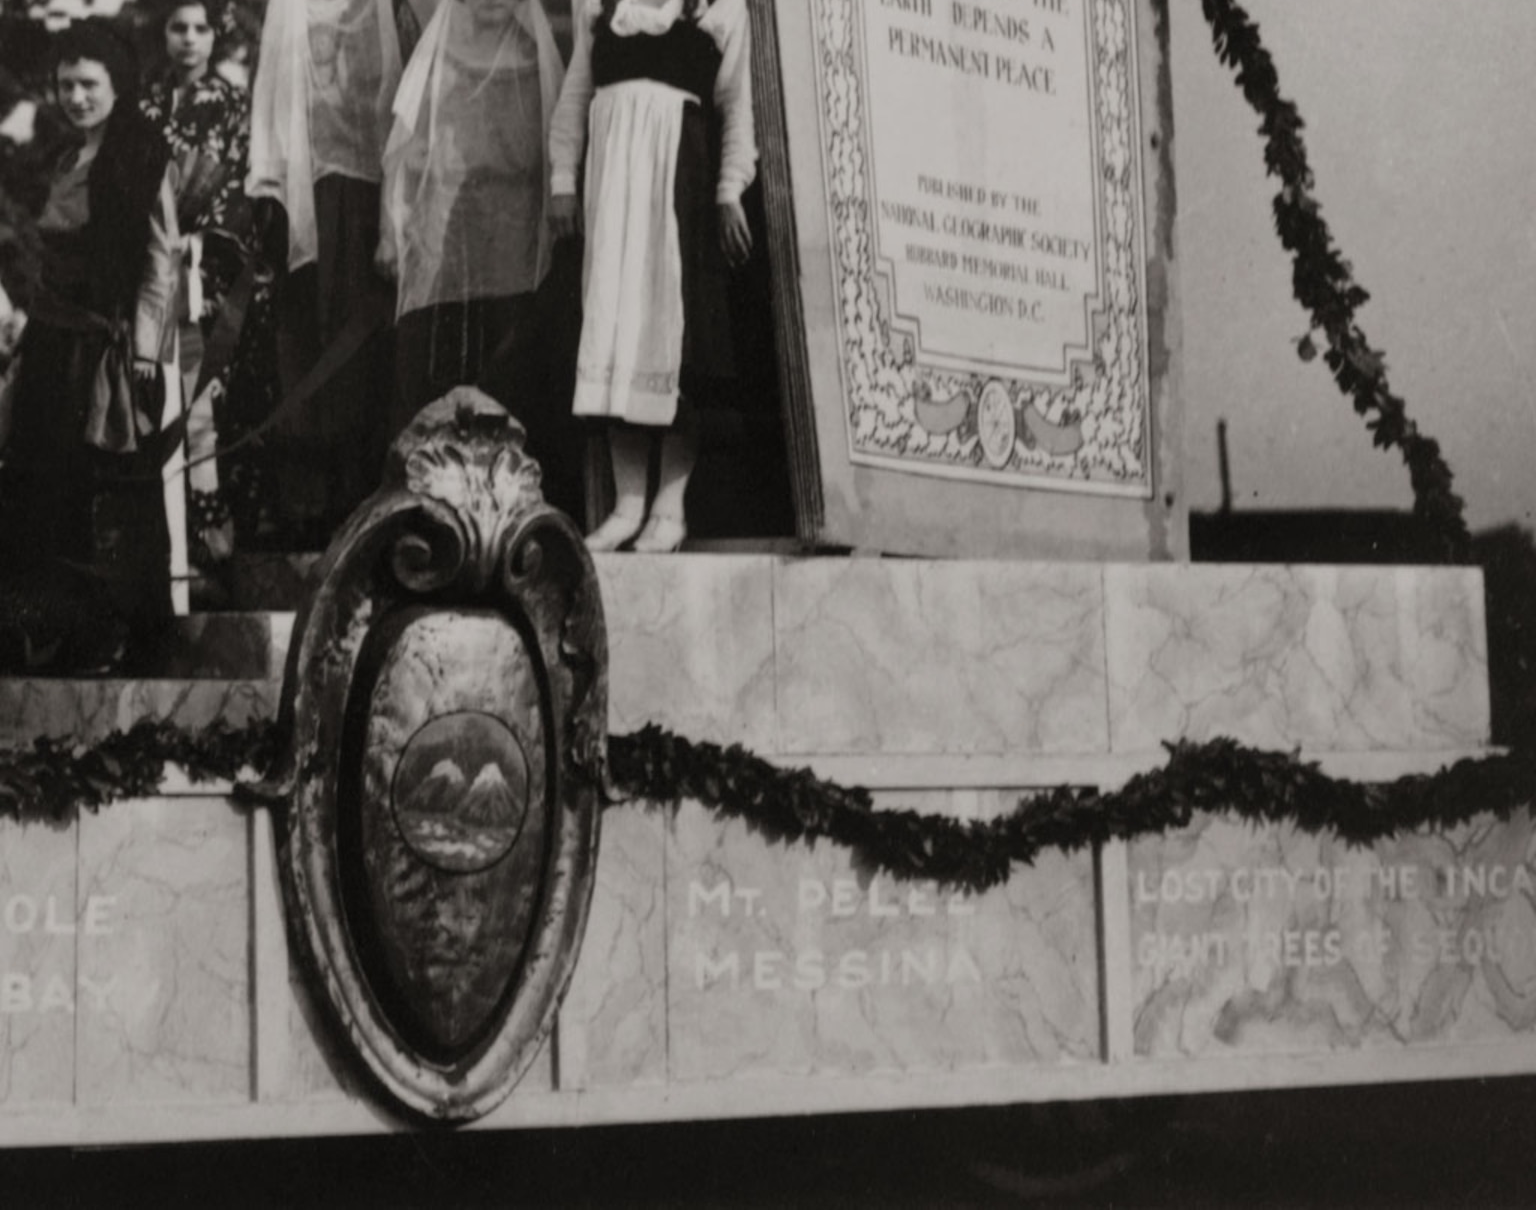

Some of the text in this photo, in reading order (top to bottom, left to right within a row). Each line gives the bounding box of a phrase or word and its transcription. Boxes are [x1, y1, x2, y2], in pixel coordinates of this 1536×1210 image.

[951, 0, 1030, 46] DEPENDS
[1040, 27, 1055, 53] A
[887, 25, 1056, 95] PERMANENT PEACE
[990, 190, 1009, 209] BY
[1012, 192, 1042, 217] THE
[941, 213, 1027, 249] GEOGRAPHIC
[1031, 230, 1091, 263] SOCIETY
[1135, 868, 1224, 903] LOST
[1230, 866, 1303, 902] CITY
[1313, 864, 1350, 902] OF
[1363, 862, 1421, 900] THE
[694, 948, 982, 992] MESSINA
[1243, 929, 1343, 968] REES
[0, 971, 120, 1013] BAY
